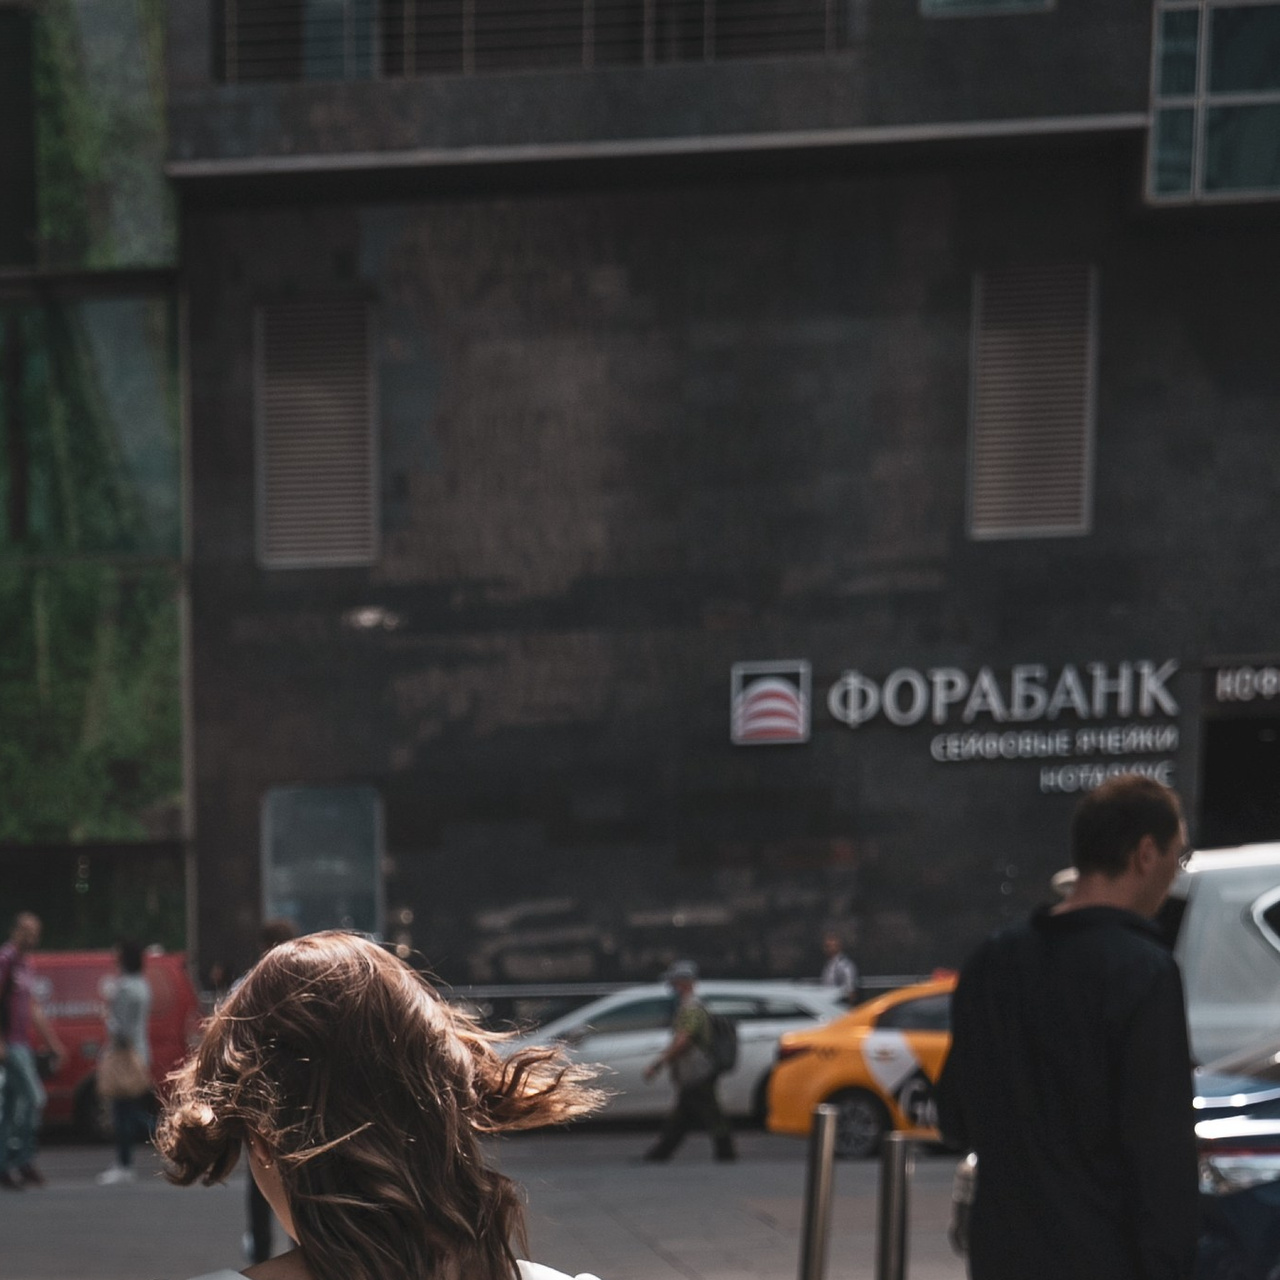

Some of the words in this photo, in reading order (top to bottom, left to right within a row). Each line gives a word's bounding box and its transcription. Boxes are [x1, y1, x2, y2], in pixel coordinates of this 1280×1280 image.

[826, 660, 1179, 727] ФОРАБАНК
[931, 731, 1072, 761] СЕЙФОВЫЕ
[1075, 724, 1179, 755] ЯЧЕЙКИ
